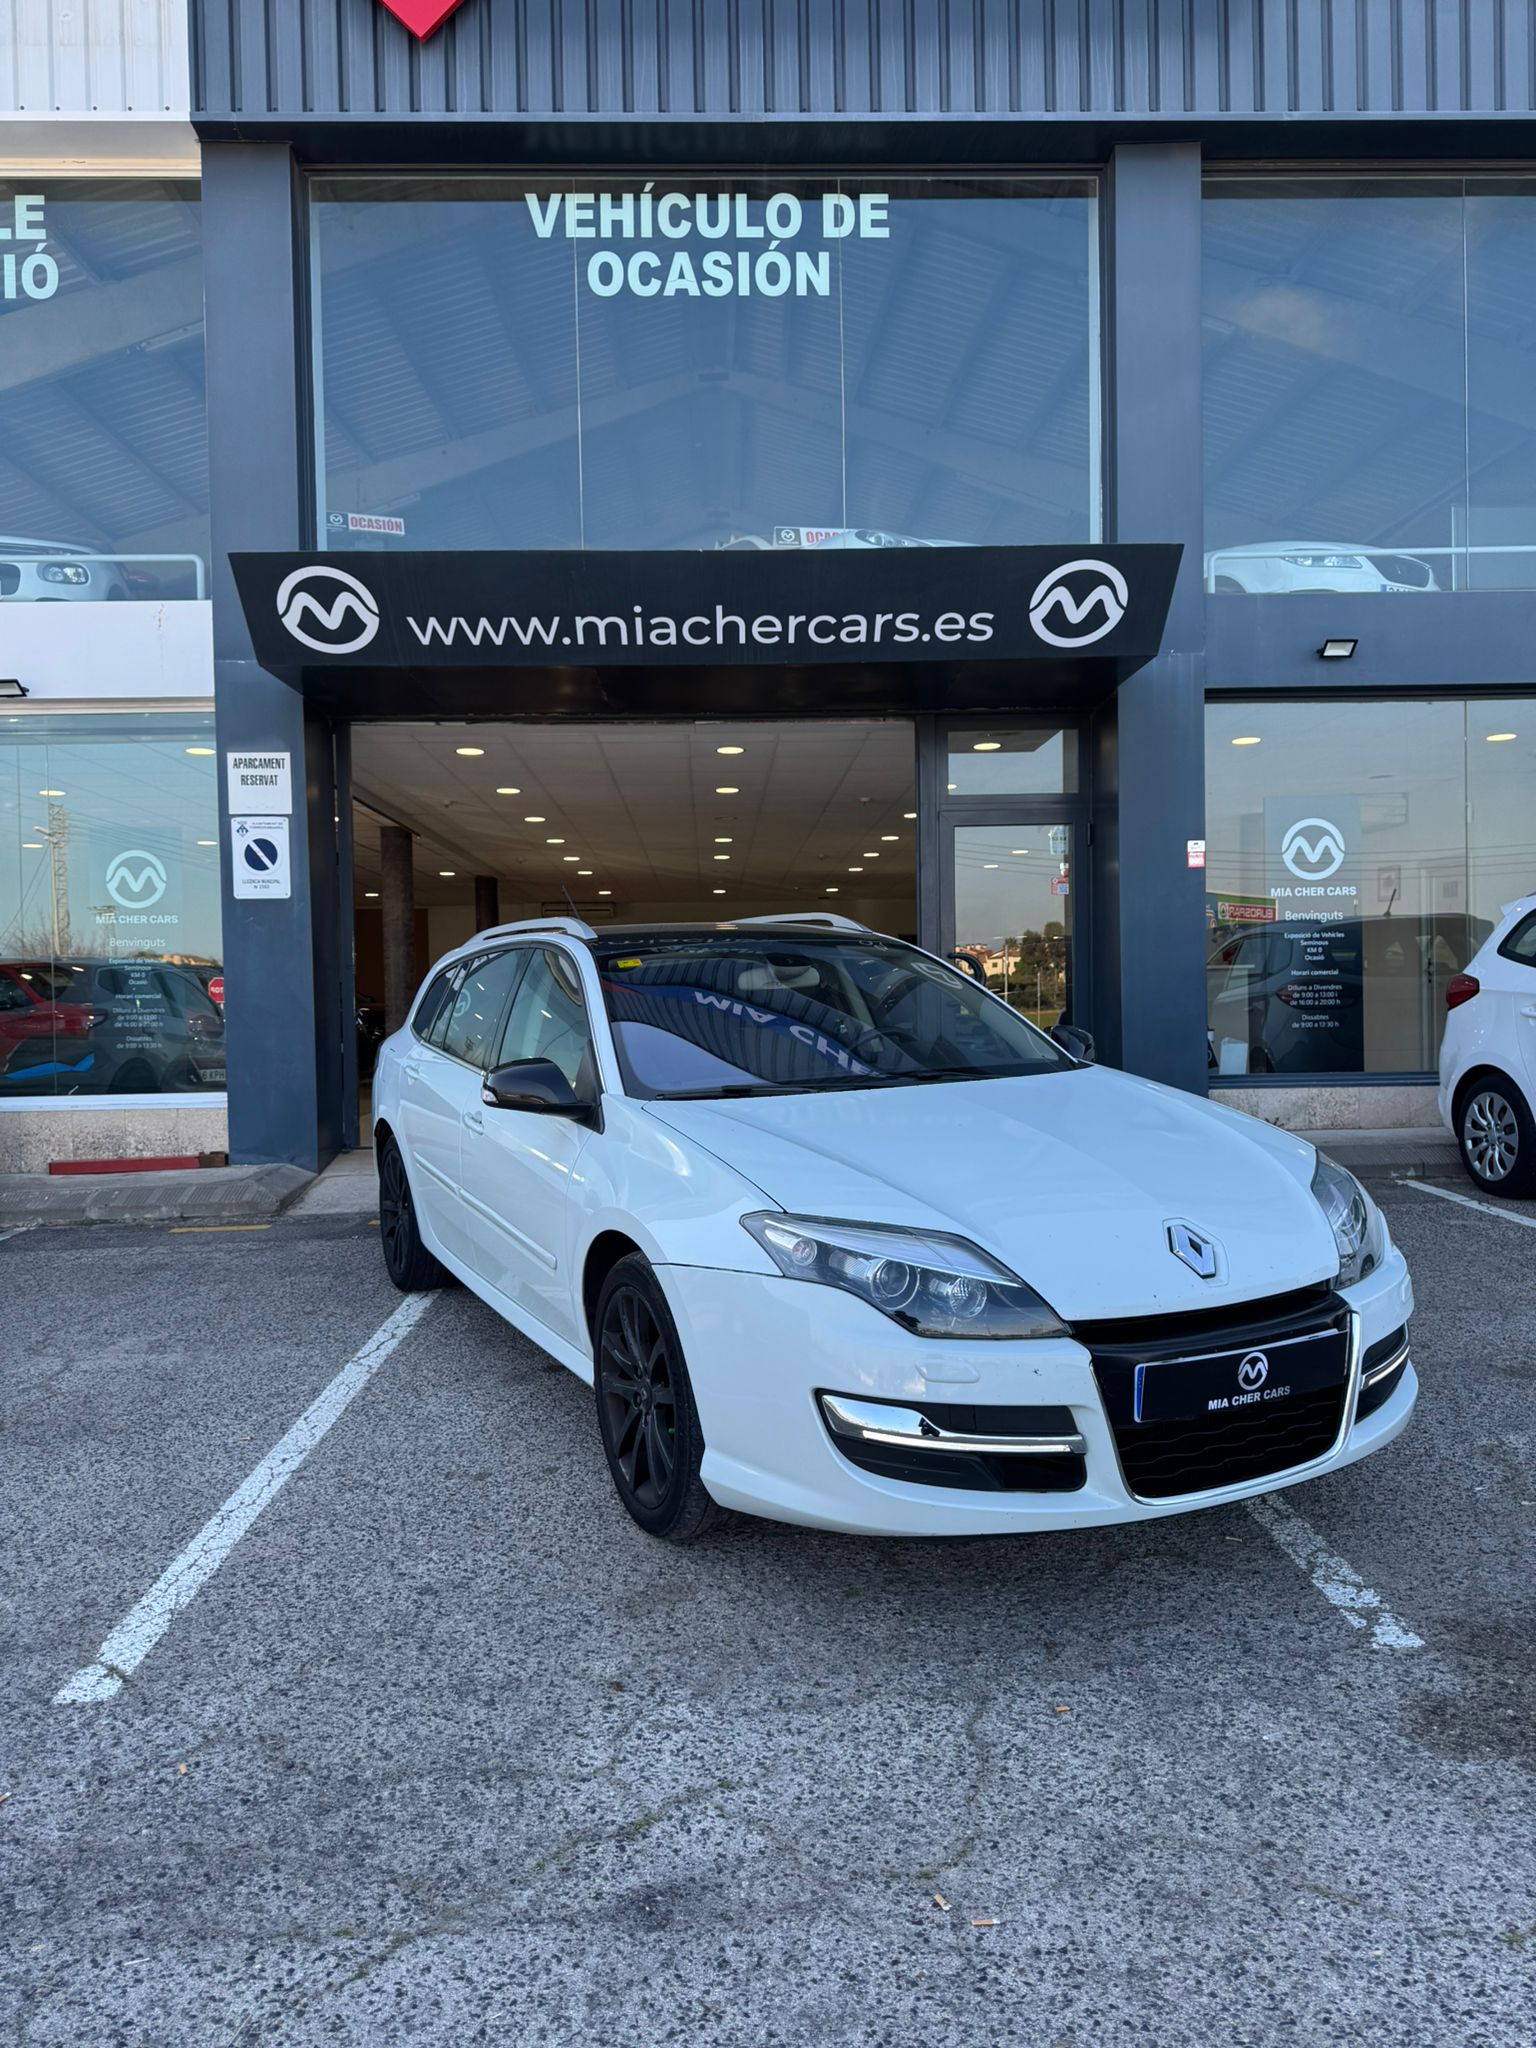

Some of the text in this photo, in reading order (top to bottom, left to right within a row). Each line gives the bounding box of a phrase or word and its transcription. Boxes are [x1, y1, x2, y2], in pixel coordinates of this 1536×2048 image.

[524, 182, 890, 239] VEHÍCULO DE
[587, 240, 830, 297] OCASIÓN
[350, 516, 403, 532] OCASIÓN
[407, 604, 995, 647] www.miachercars.es
[233, 757, 285, 769] APARCAMENT
[240, 775, 278, 786] RESERVAT
[1270, 886, 1357, 897] MIA CHER CARS
[96, 914, 178, 924] MIA CHER CARS
[1285, 910, 1344, 923] Benvinguts
[1284, 932, 1311, 940] Exposició
[110, 937, 166, 949] Benvinguts
[1208, 1385, 1291, 1411] MIA CHER CARS
